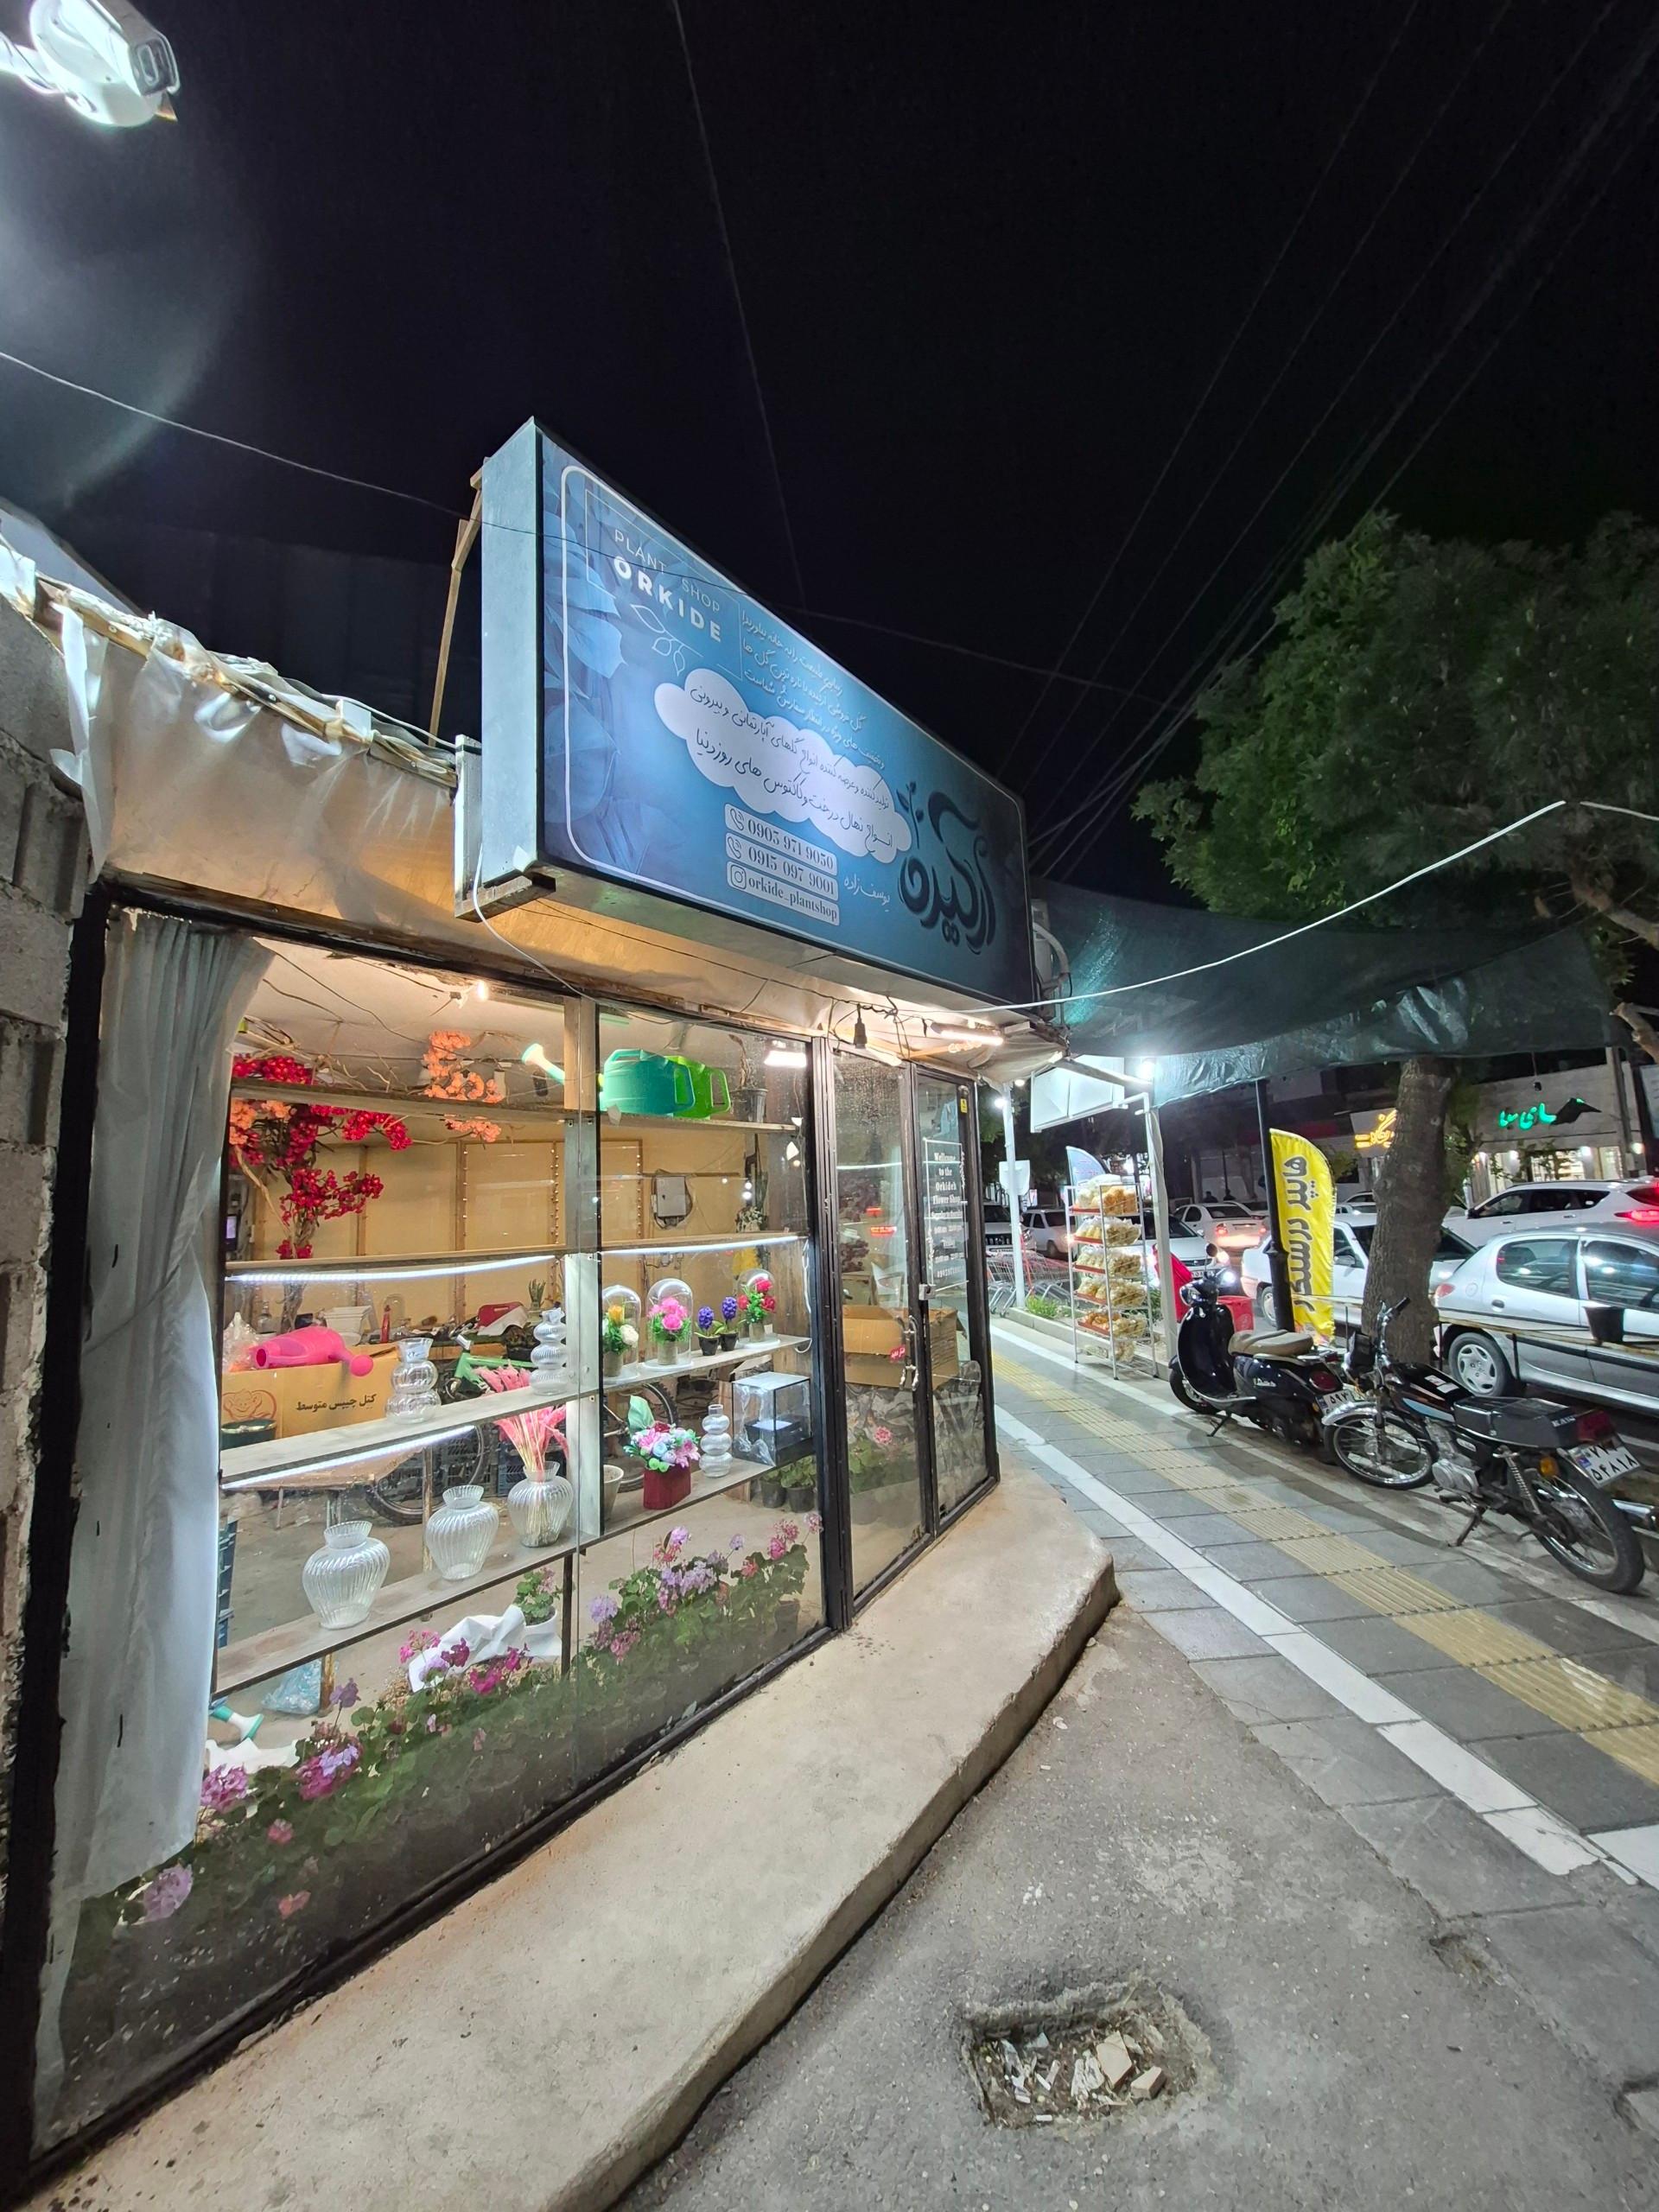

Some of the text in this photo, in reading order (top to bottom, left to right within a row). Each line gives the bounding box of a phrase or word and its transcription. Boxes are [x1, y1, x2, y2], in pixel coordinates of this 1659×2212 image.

[614, 529, 720, 612] PLANT SHOP
[614, 556, 721, 642] ORKIDE
[743, 638, 753, 653] ها
[768, 632, 783, 648] خانه
[754, 649, 776, 666] گل
[799, 657, 823, 678] طبیعت
[744, 669, 775, 694] شماست
[791, 677, 802, 690] تازه
[829, 702, 849, 723] فروشی
[850, 712, 868, 731] گل
[732, 710, 775, 742] آپارتمانی
[843, 736, 858, 751] های
[799, 750, 818, 774] انواع
[820, 754, 845, 778] کننده
[809, 795, 839, 820] درخت
[840, 810, 863, 832] نهال
[784, 835, 802, 855] 971
[864, 824, 893, 853] انواع
[748, 846, 835, 895] 0915 097 9001
[748, 873, 838, 922] orkide_plantshop
[938, 1166, 944, 1176] to
[1282, 1155, 1319, 1211] هایپر
[932, 1195, 950, 1205] Flower
[296, 1400, 327, 1413] متوسط
[1590, 1453, 1637, 1481] ۵۴۸۱۸
